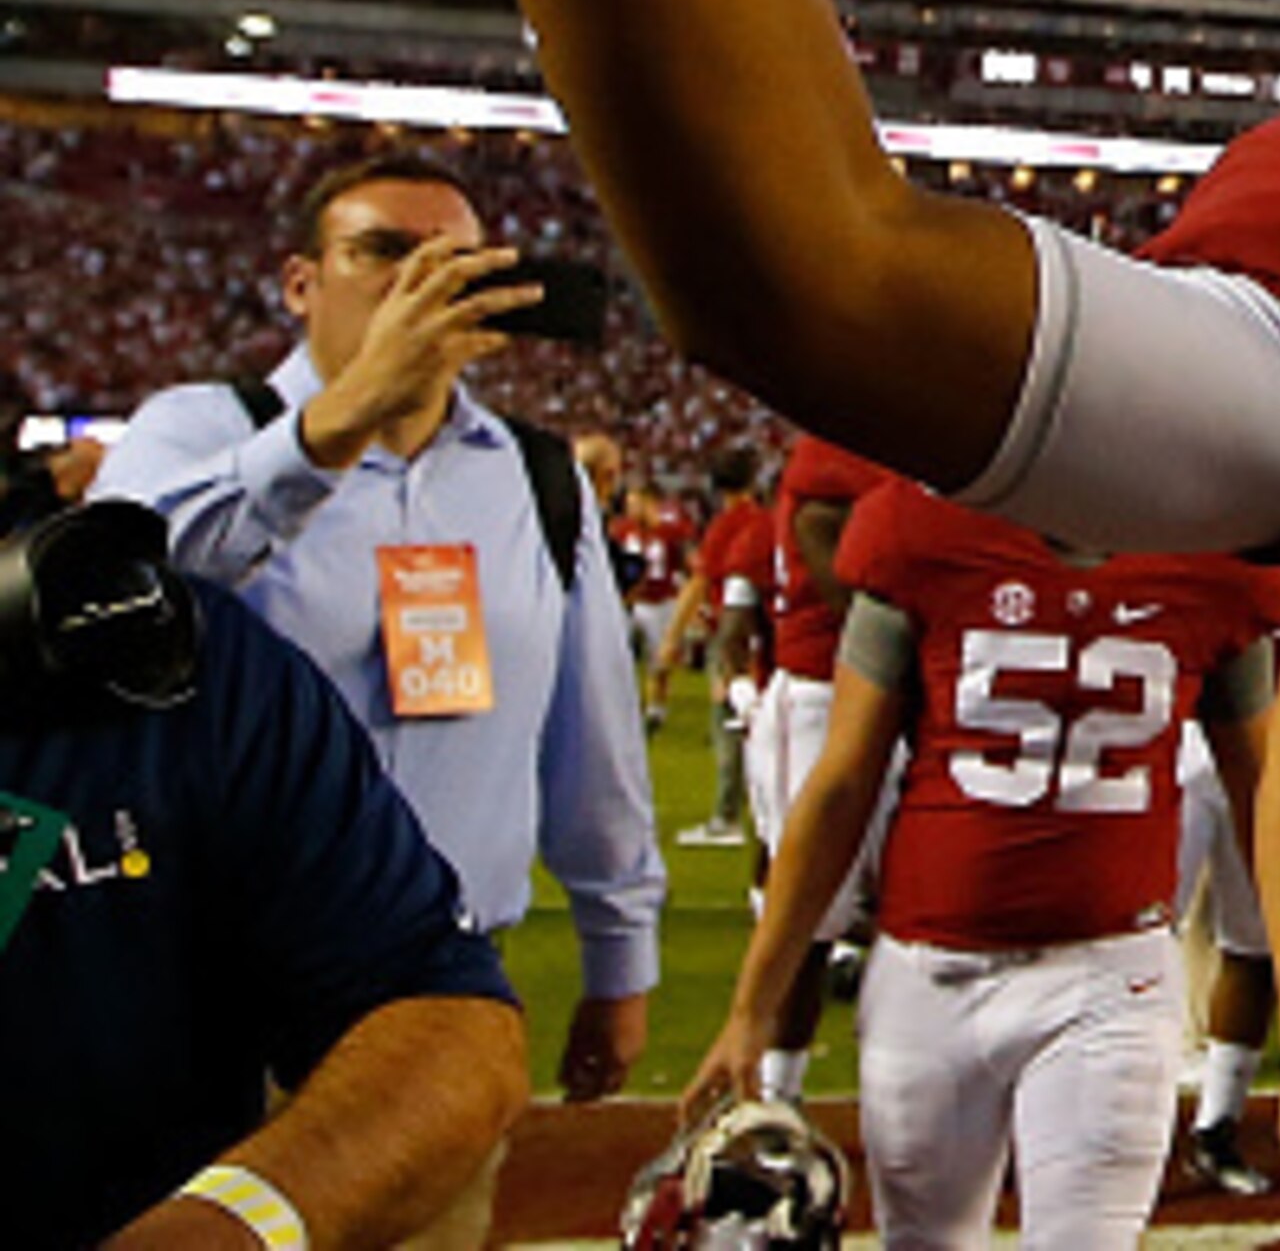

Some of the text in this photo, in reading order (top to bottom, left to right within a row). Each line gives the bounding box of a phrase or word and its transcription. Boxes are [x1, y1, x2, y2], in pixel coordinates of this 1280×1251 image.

[419, 634, 455, 666] M
[402, 664, 482, 698] 040
[950, 629, 1177, 814] 52
